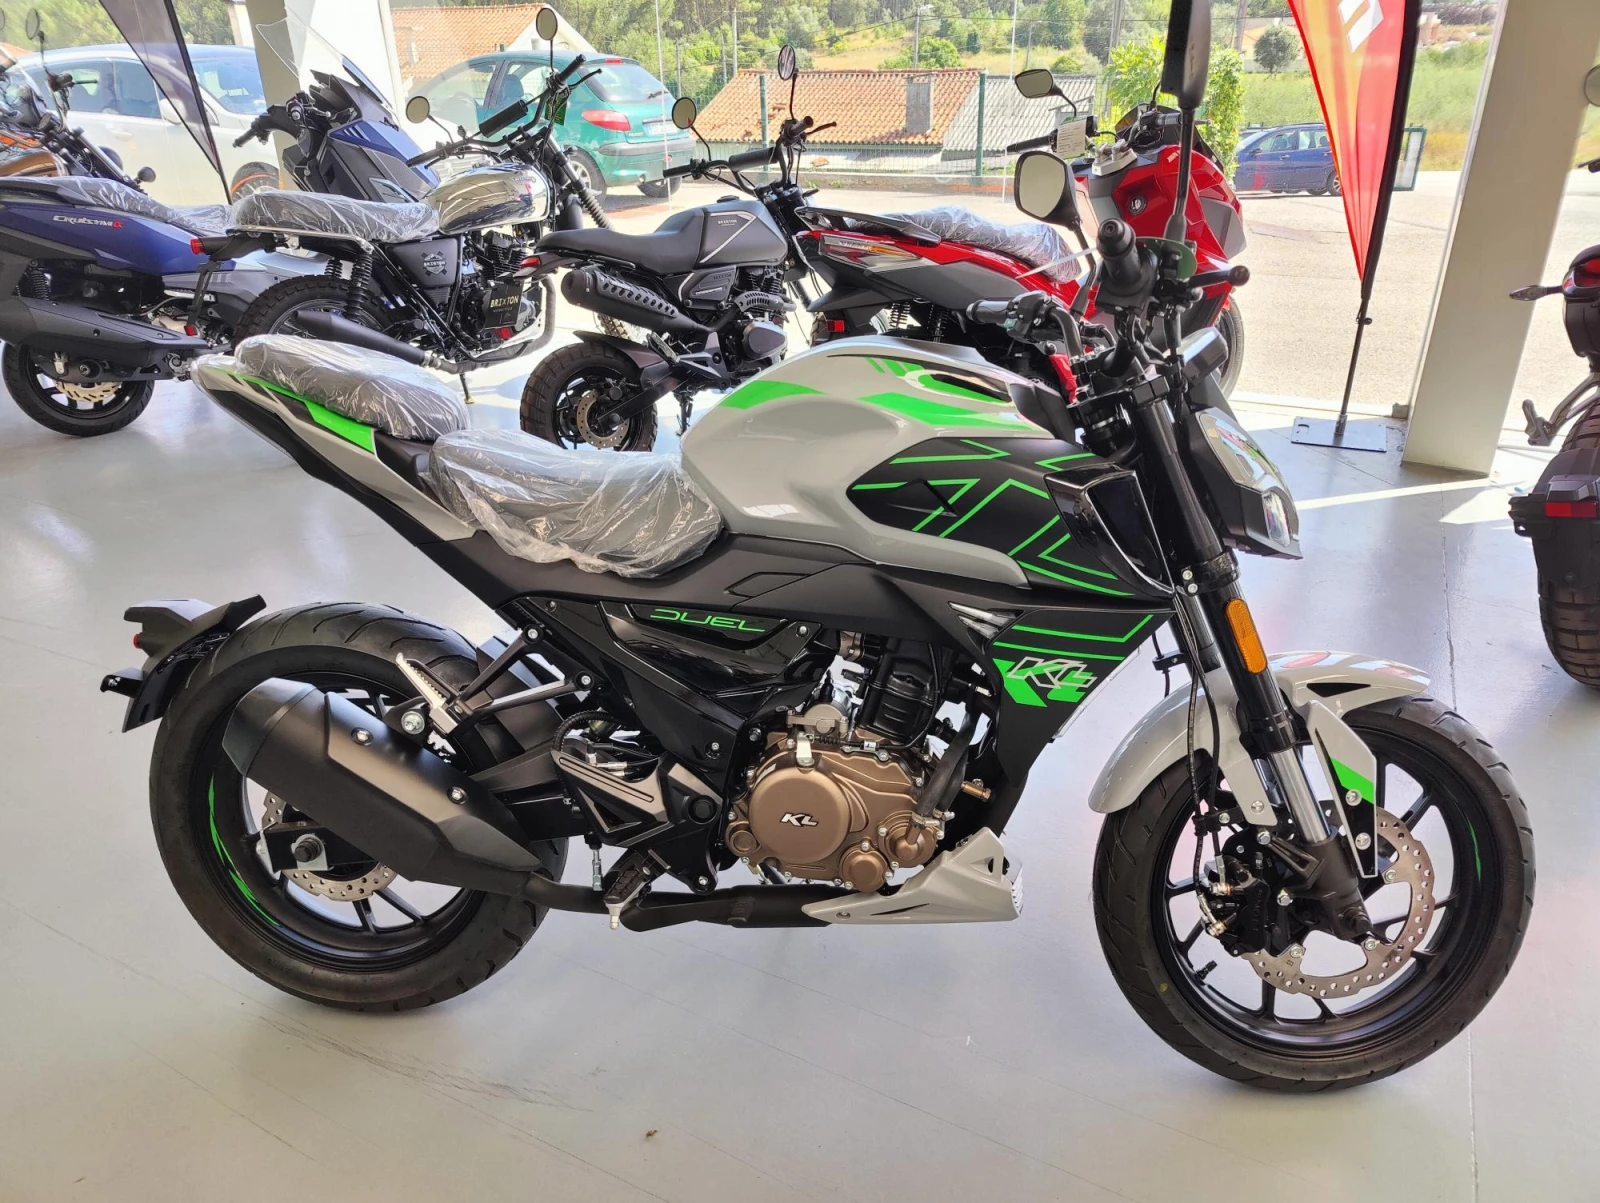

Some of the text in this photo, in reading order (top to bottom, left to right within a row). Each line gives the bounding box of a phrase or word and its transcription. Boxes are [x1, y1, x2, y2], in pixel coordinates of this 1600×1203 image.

[490, 295, 520, 308] BRIXTON
[650, 608, 766, 633] DUEL
[780, 812, 819, 827] KL
